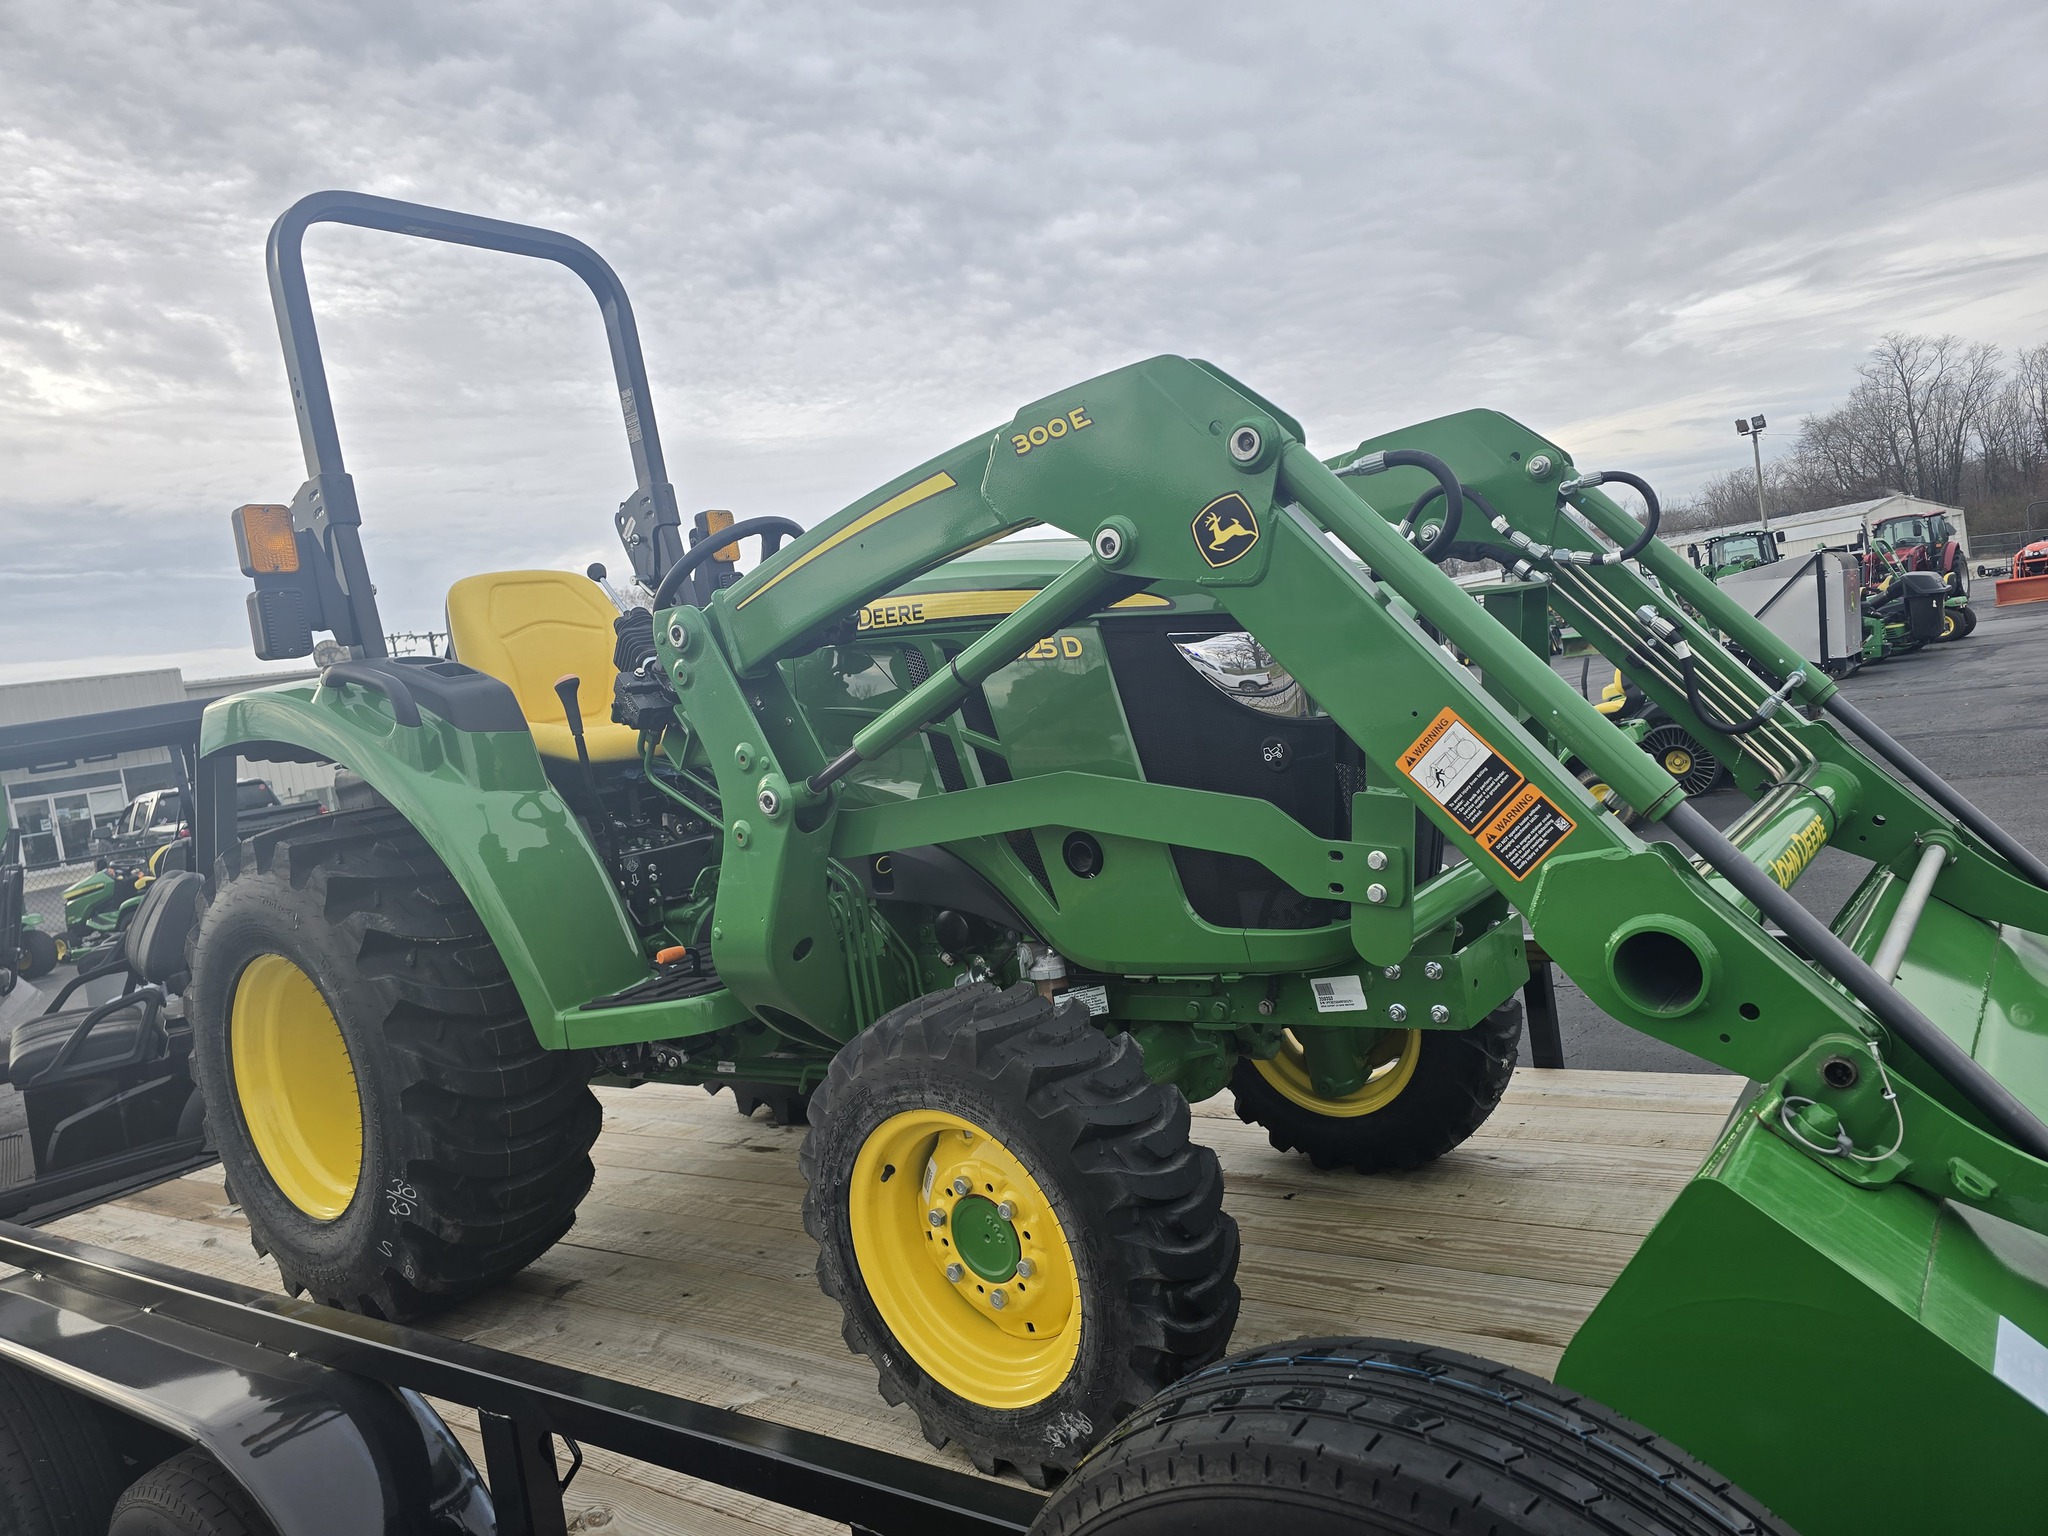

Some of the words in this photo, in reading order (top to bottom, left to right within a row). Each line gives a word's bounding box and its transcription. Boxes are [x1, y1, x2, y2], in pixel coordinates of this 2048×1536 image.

[857, 602, 925, 630] DEERE
[1413, 718, 1450, 757] WARNING
[1494, 793, 1533, 832] WARNING
[1768, 844, 1802, 889] JOHN
[1790, 814, 1827, 868] DEERE
